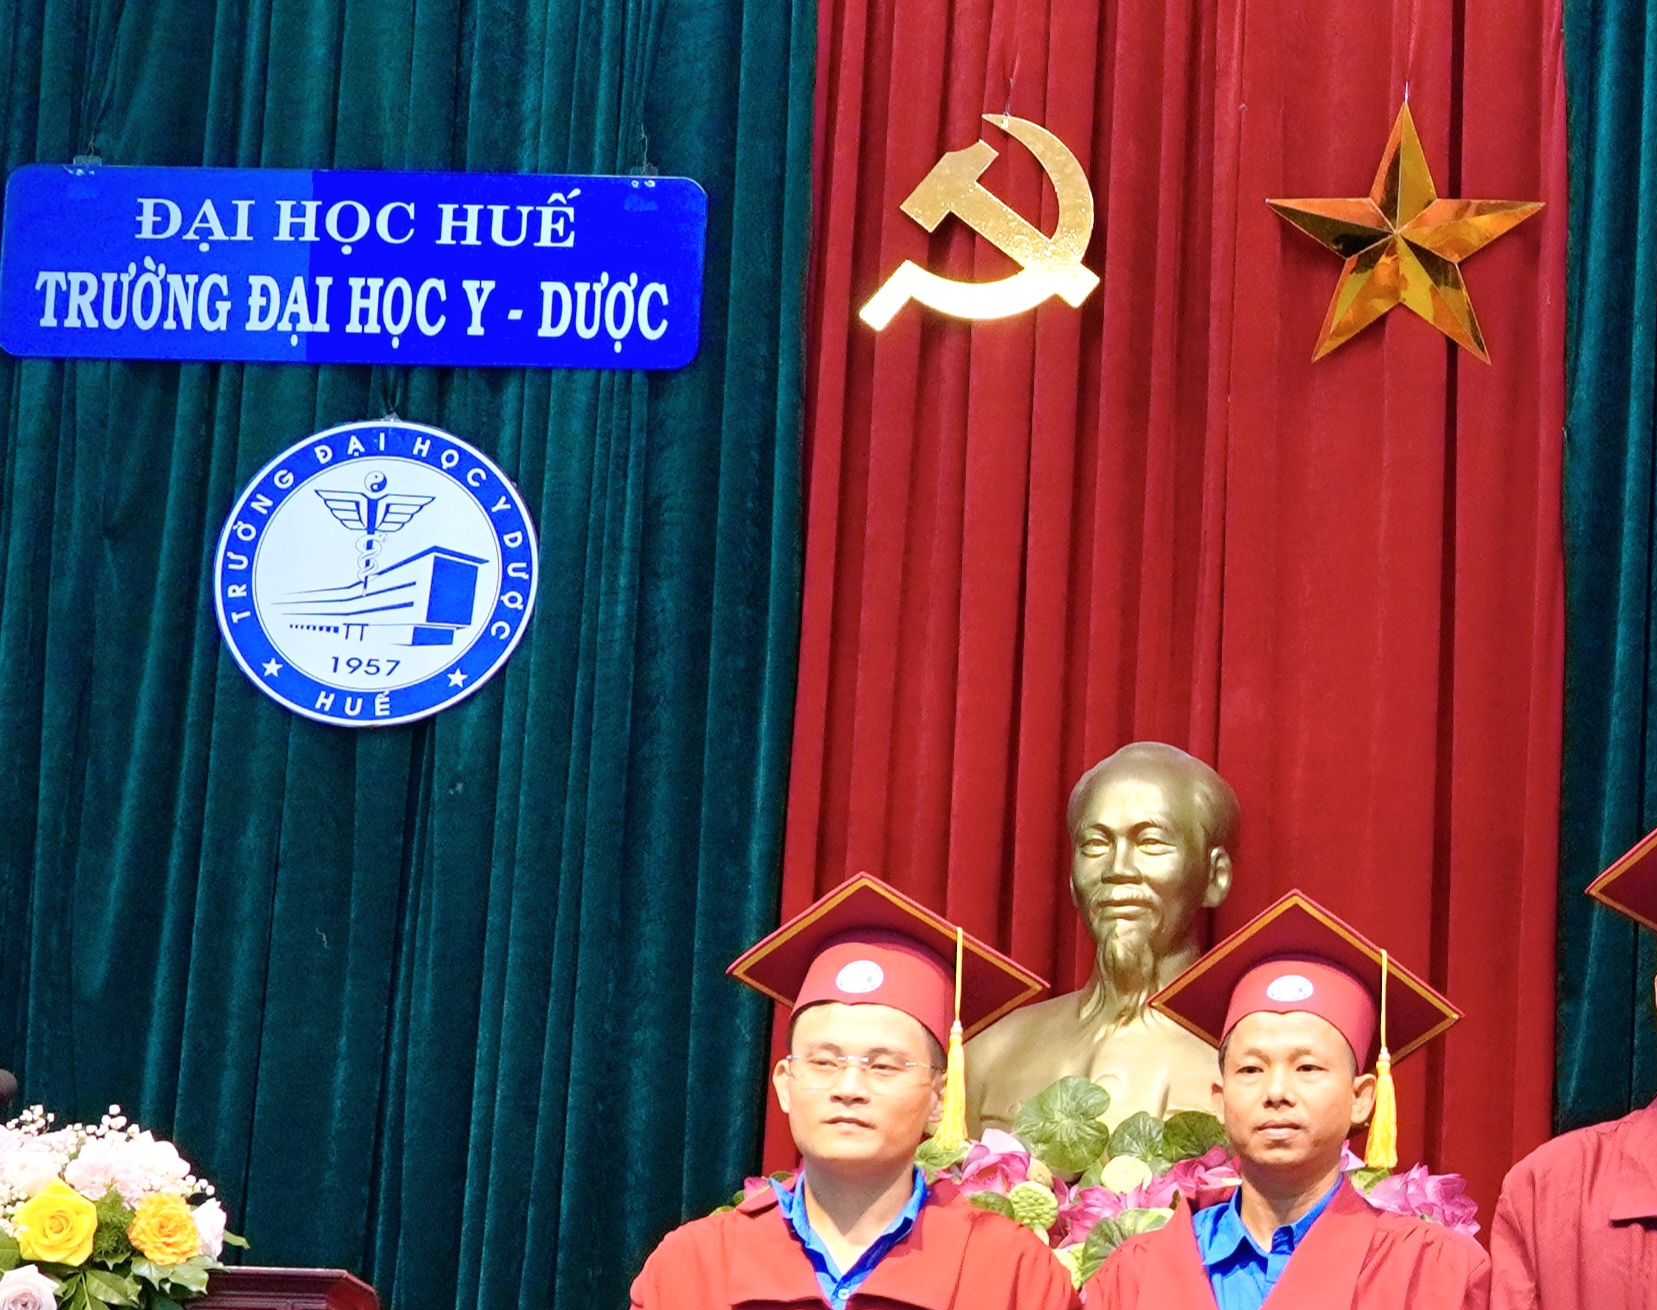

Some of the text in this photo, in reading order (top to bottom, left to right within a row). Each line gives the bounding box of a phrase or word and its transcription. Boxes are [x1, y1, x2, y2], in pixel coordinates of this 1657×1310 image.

[136, 189, 580, 254] ĐẠI HỌC HUẾ
[36, 256, 668, 352] TRƯỜNG ĐẠI HỌC Y - DƯỢC
[313, 432, 386, 465] ĐẠI
[412, 436, 487, 488] HỌC
[490, 494, 512, 514] Y
[488, 530, 530, 641] DƯỢC
[330, 655, 401, 677] 1957
[314, 688, 391, 717] HUẾ
